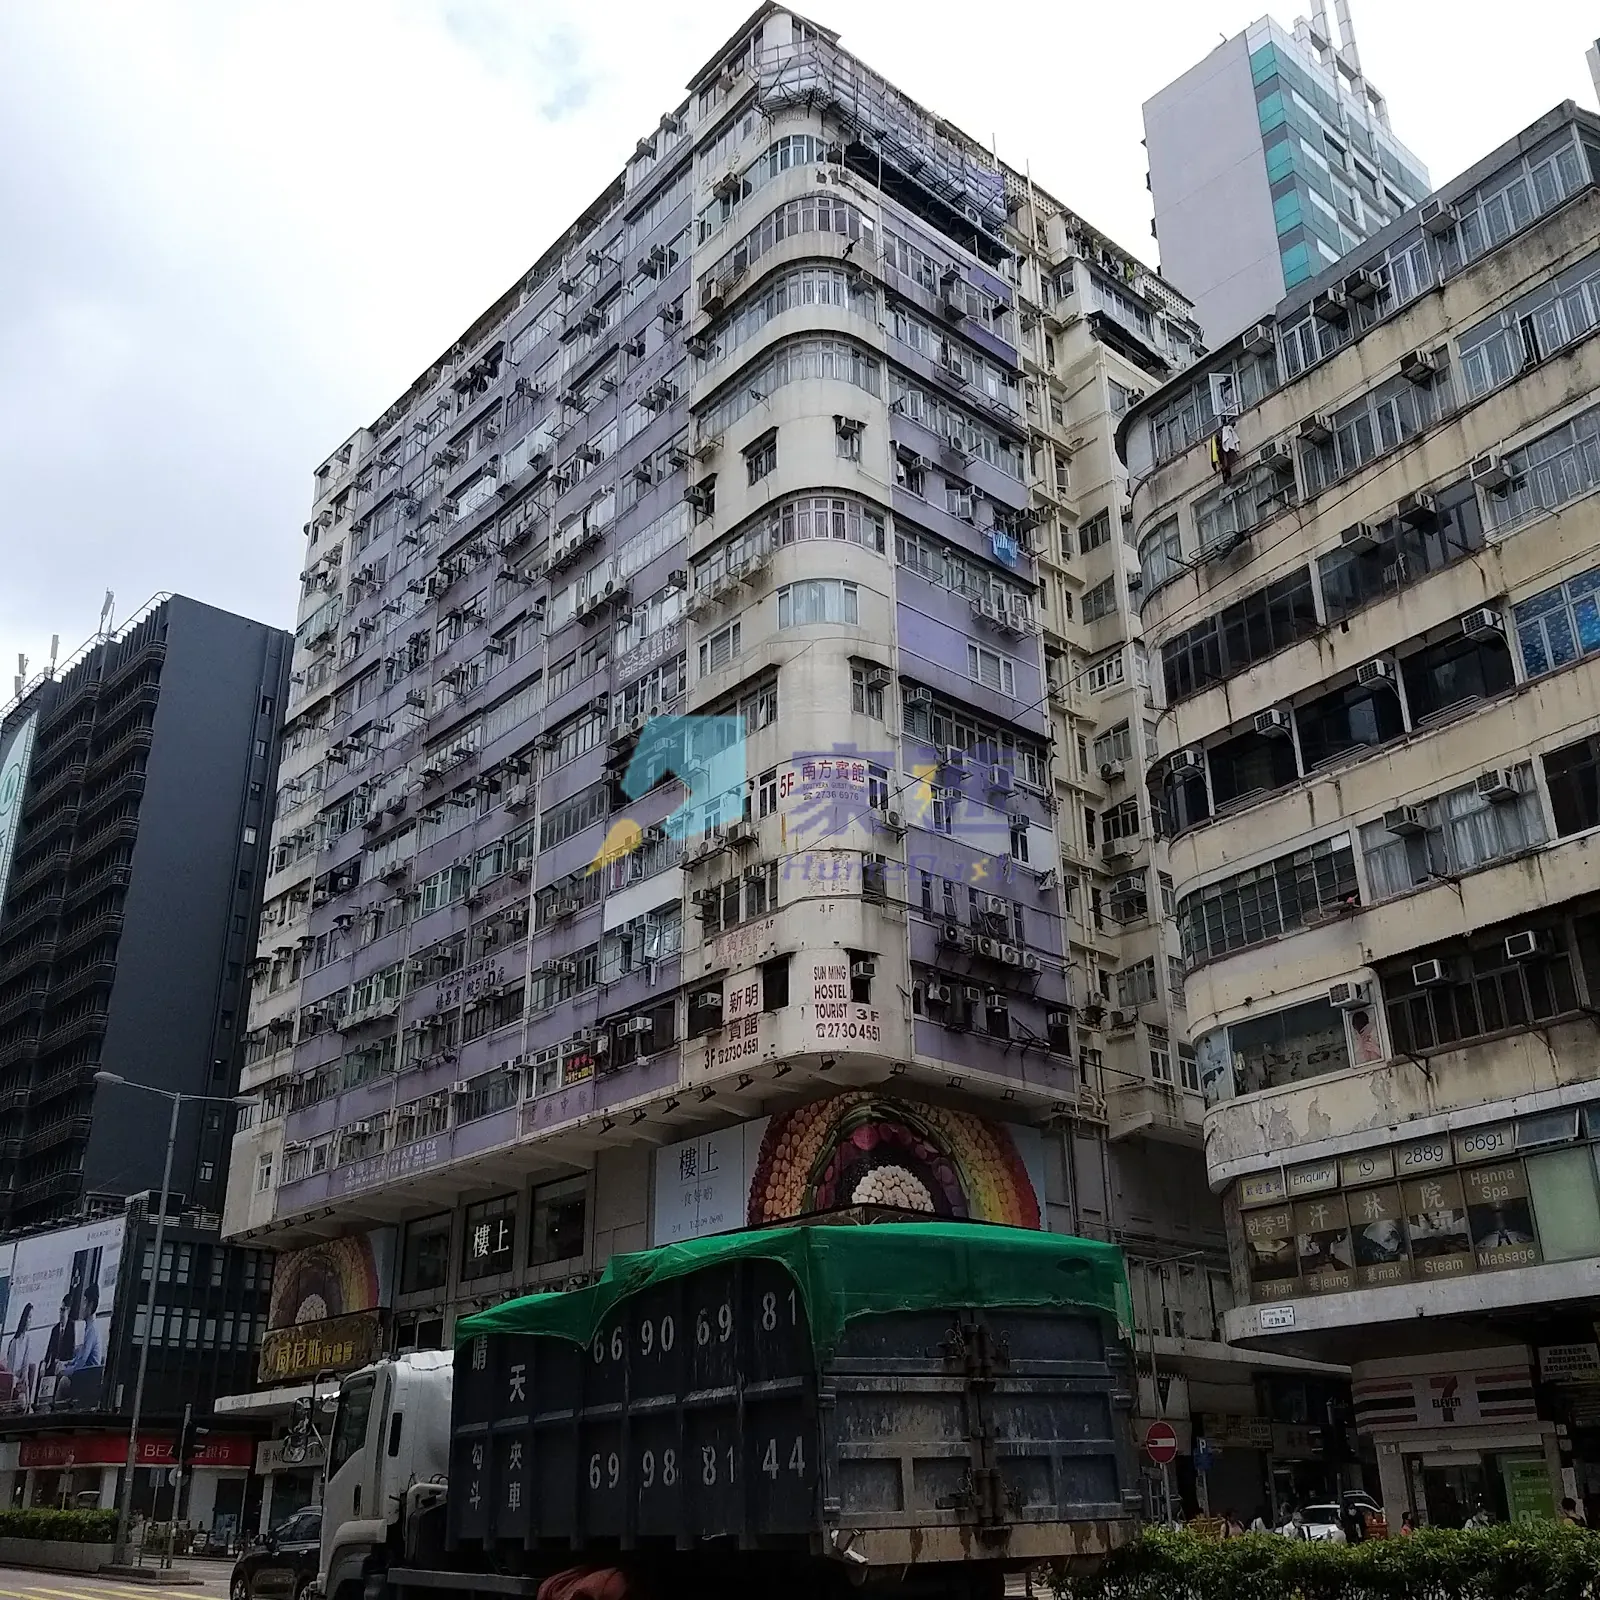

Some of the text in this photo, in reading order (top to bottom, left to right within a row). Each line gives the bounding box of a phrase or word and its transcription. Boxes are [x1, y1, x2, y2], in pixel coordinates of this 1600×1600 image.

[618, 645, 664, 681] 95129283
[779, 759, 865, 798] 5F 南方賓館
[816, 790, 860, 801] 2736 6976
[849, 784, 865, 793] HOUSE
[813, 966, 847, 981] SUN MING
[729, 983, 759, 1014] 新明
[814, 983, 847, 1000] HOSTEL
[815, 1003, 880, 1022] TOURIST 3F
[728, 1014, 758, 1043] 賓館
[704, 1048, 716, 1070] 3F
[1404, 1132, 1505, 1165] 2889 6691
[679, 1142, 719, 1181] 樓上
[1293, 1169, 1331, 1186] Enquiry
[1470, 1168, 1516, 1186] Hanna
[1481, 1185, 1509, 1201] Spa
[1246, 1212, 1291, 1236] 한증막
[473, 1219, 510, 1258] 樓上
[1424, 1258, 1464, 1273] Steam
[1478, 1248, 1536, 1266] Massage
[1378, 1266, 1402, 1281] mak
[1273, 1283, 1293, 1295] han
[1320, 1275, 1349, 1291] jeung
[592, 1288, 797, 1364] 66 90 69 81
[1430, 1376, 1458, 1421] 7
[1199, 1439, 1207, 1454] P
[588, 1435, 807, 1490] 69 98 81 44
